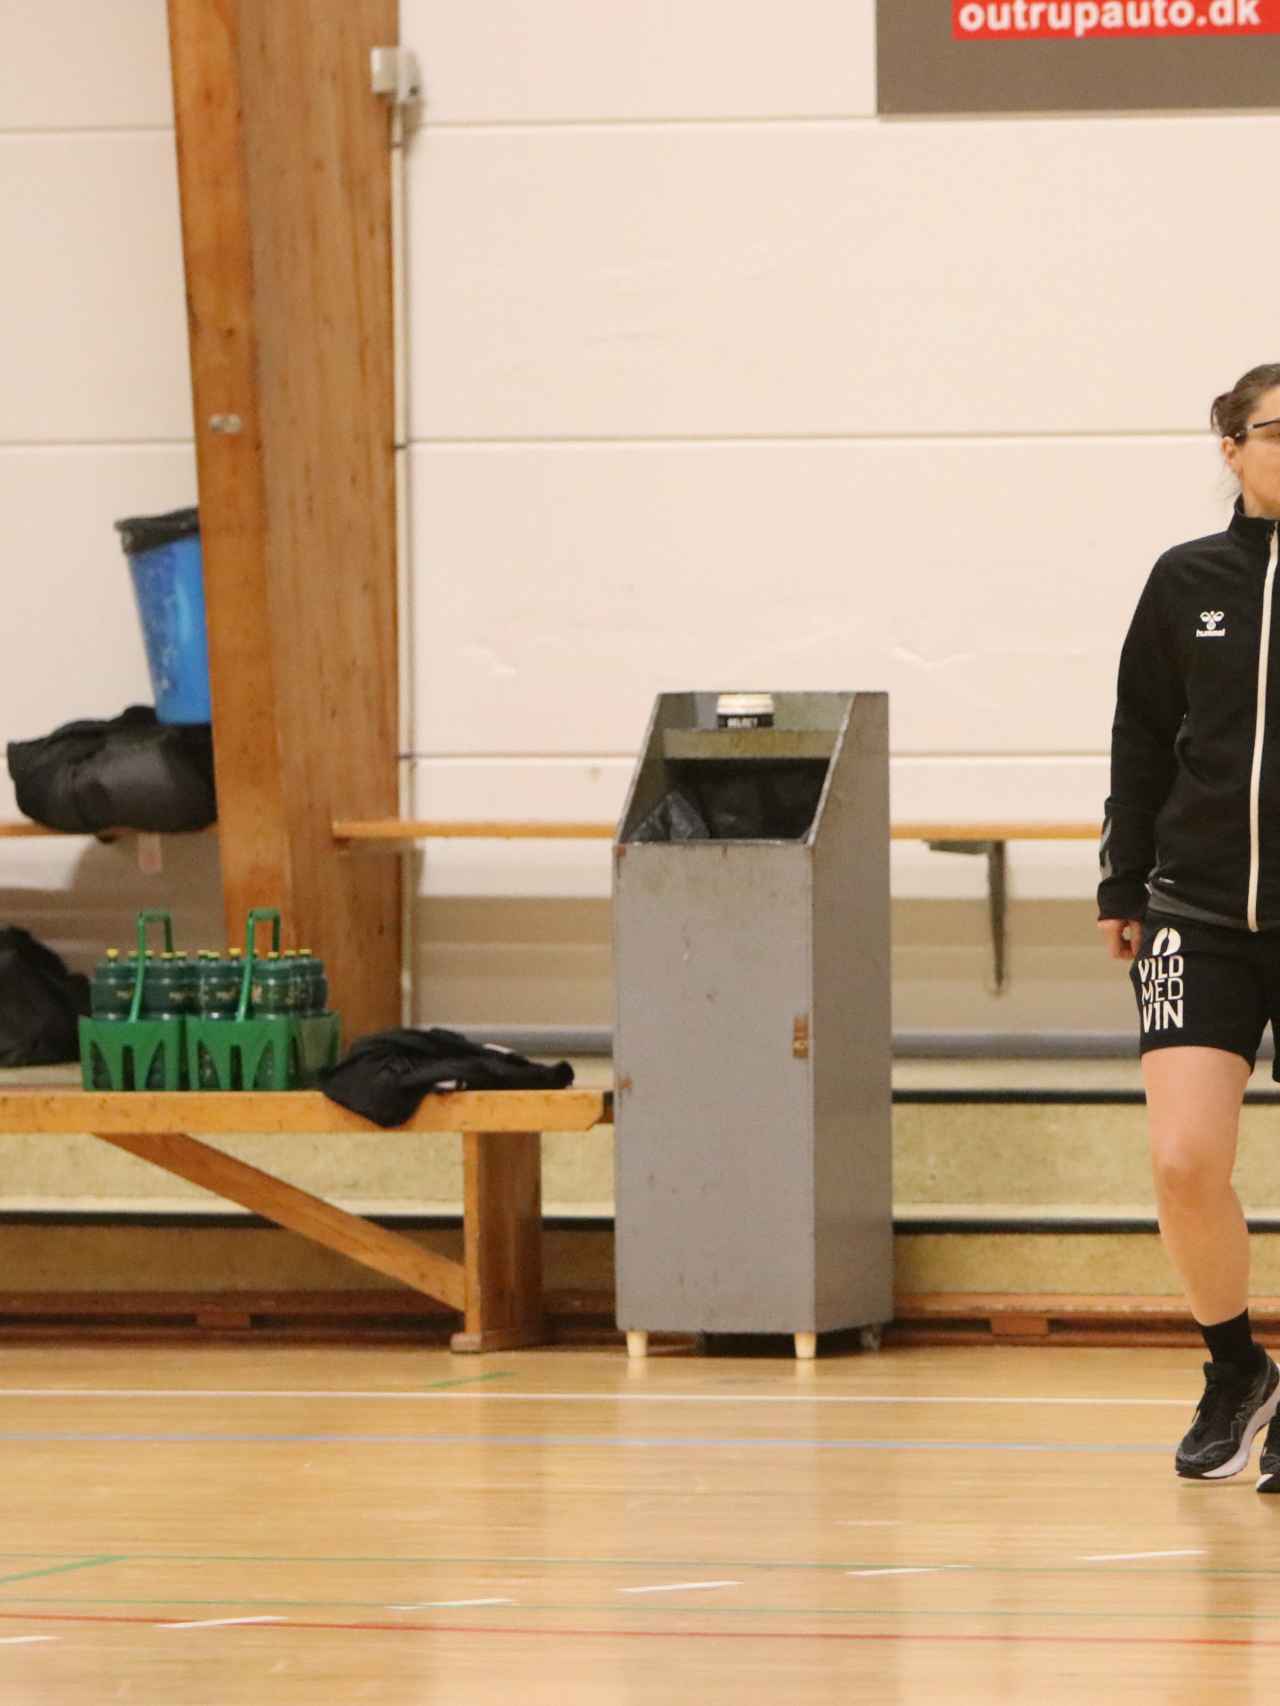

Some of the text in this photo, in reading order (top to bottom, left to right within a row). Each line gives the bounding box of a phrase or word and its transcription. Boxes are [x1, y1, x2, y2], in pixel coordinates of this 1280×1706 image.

[958, 0, 1261, 37] outrupauto.dk
[1138, 955, 1184, 983] VILD
[1141, 977, 1184, 1005] MED
[1142, 999, 1184, 1033] VIN
